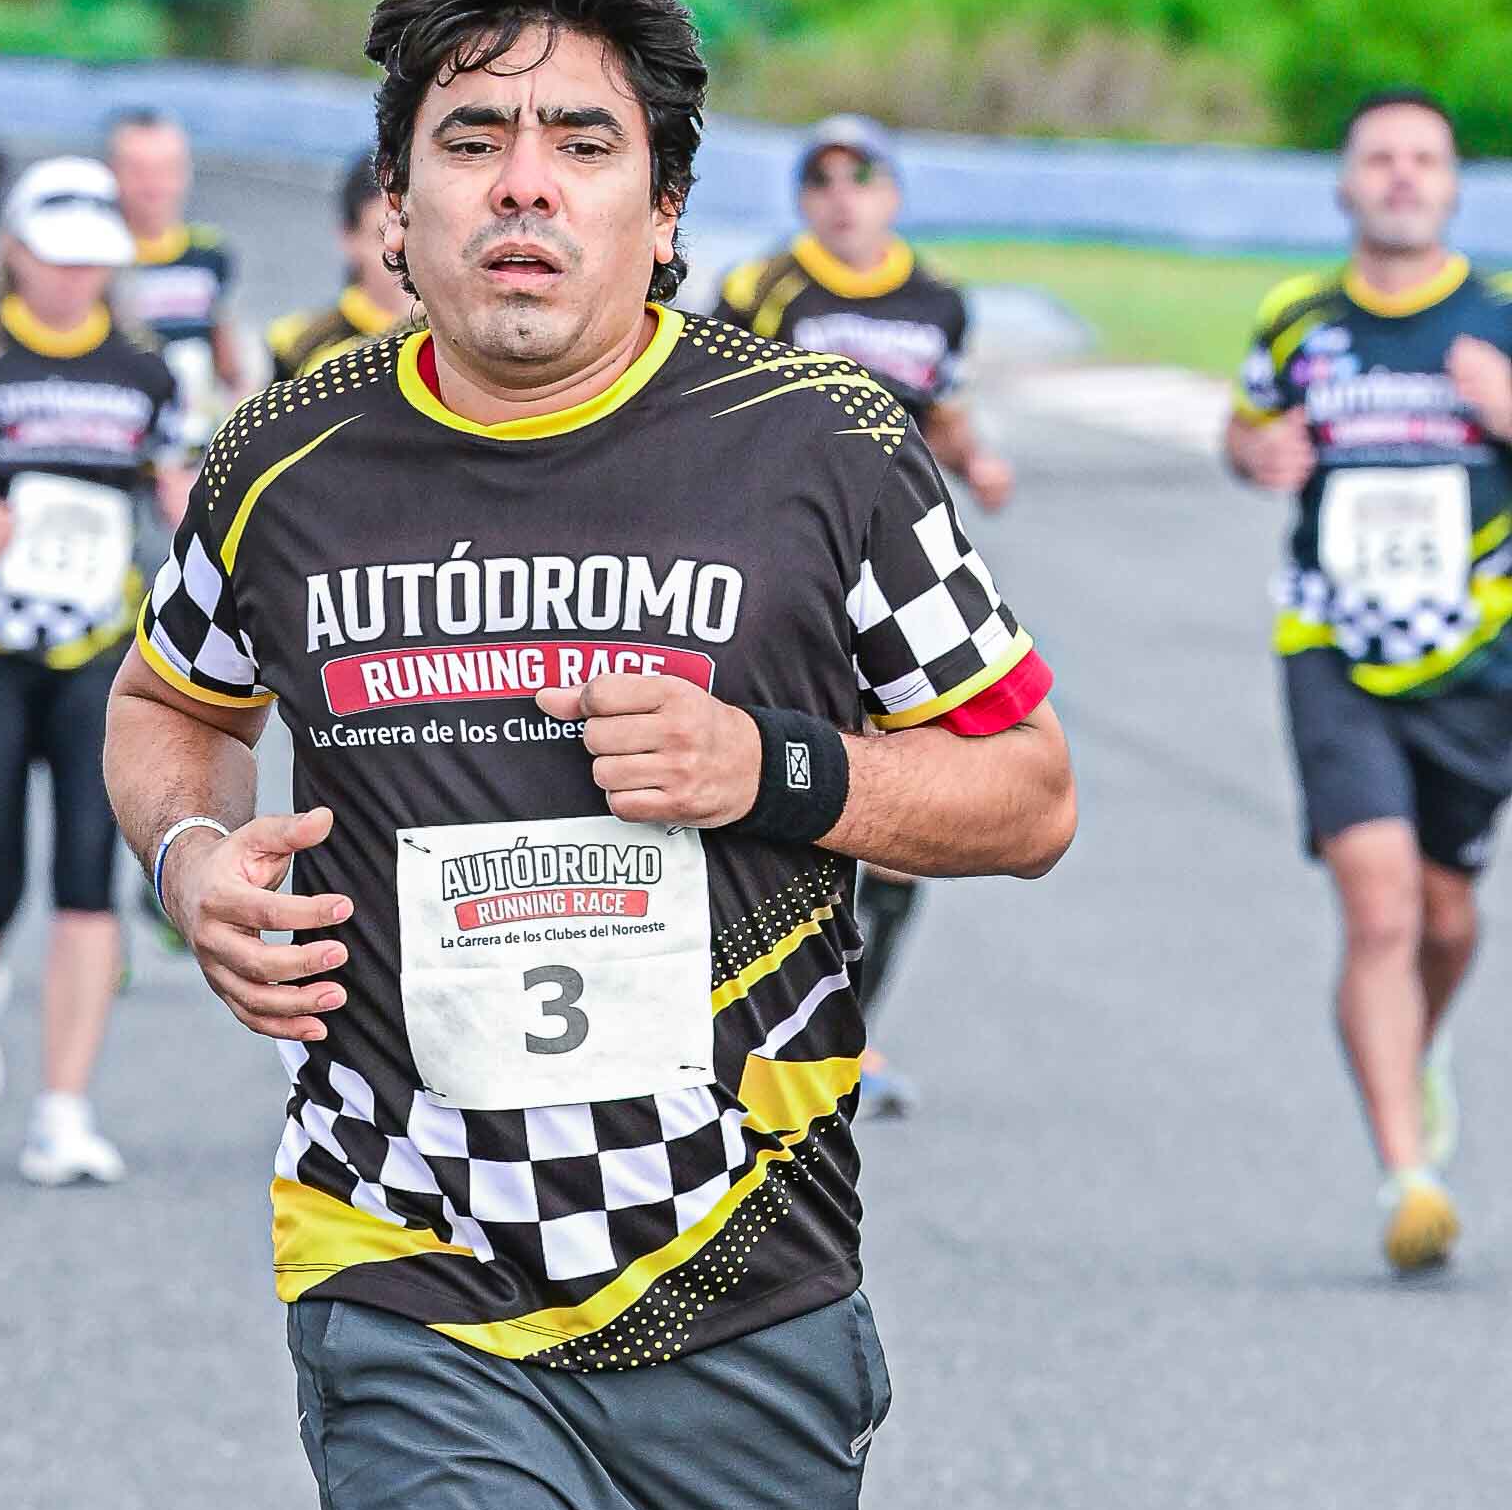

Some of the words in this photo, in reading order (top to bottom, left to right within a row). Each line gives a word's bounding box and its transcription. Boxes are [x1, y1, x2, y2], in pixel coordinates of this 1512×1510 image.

[306, 541, 744, 653] AUTÓDROMO
[360, 648, 545, 705] RUNNING
[309, 725, 332, 748] La
[331, 723, 416, 747] Carrera
[421, 719, 454, 743] de
[460, 719, 498, 743] los
[441, 836, 662, 901] AUTÓDROMO
[441, 936, 454, 948] La
[457, 934, 501, 948] Carrera
[504, 931, 520, 944] de
[523, 929, 542, 943] los
[544, 928, 587, 941] Clubes
[590, 924, 609, 937] del
[612, 922, 665, 936] Noroeste
[475, 890, 566, 925] RUNNING
[573, 891, 626, 914] RACE
[523, 964, 589, 1054] 3
